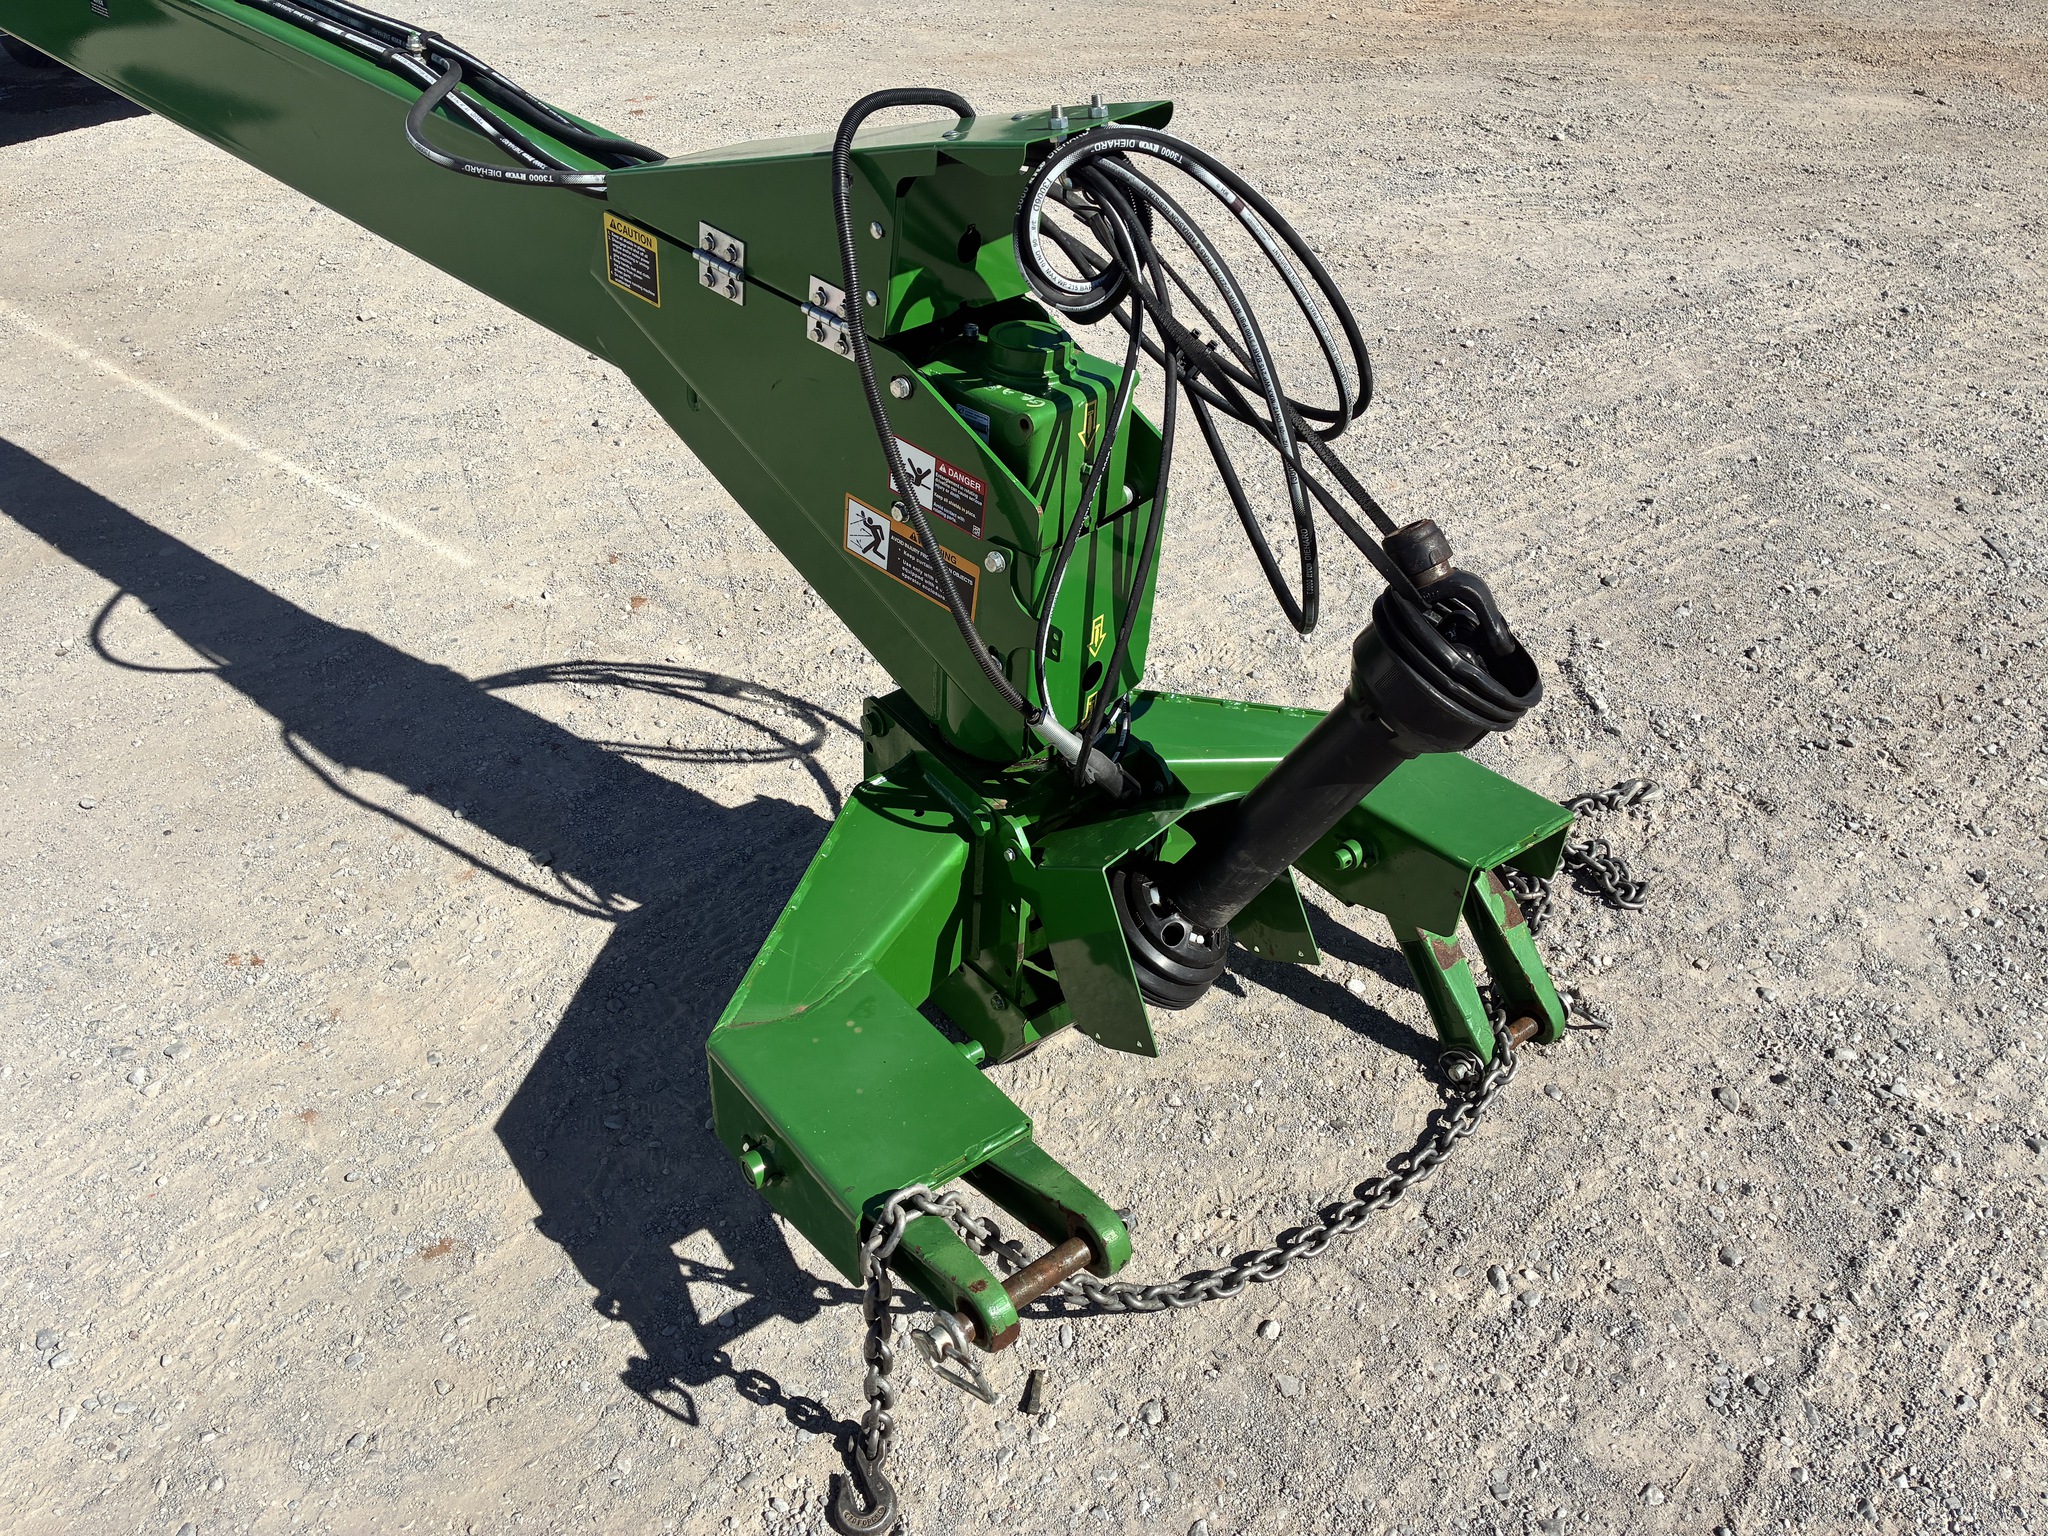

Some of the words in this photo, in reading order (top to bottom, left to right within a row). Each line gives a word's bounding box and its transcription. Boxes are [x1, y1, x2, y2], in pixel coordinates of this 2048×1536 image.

[1092, 139, 1135, 151] DIEHARD
[1159, 145, 1184, 164] T3000
[463, 163, 502, 177] DIEHARD
[528, 173, 554, 182] T3000
[1140, 186, 1171, 214] RESISTANT
[616, 221, 652, 248] CAUTION
[1169, 212, 1197, 243] ABRASION
[1043, 268, 1058, 281] MAX
[1239, 315, 1248, 327] PSI
[1253, 347, 1262, 362] BAR
[1268, 389, 1276, 403] MAX
[948, 468, 980, 491] DANGER
[1300, 528, 1311, 560] DIEHARD
[890, 534, 904, 546] AVOID
[904, 542, 919, 555] INJURY
[952, 569, 973, 586] OBJECTS
[903, 549, 915, 561] Keep
[902, 559, 911, 568] Use
